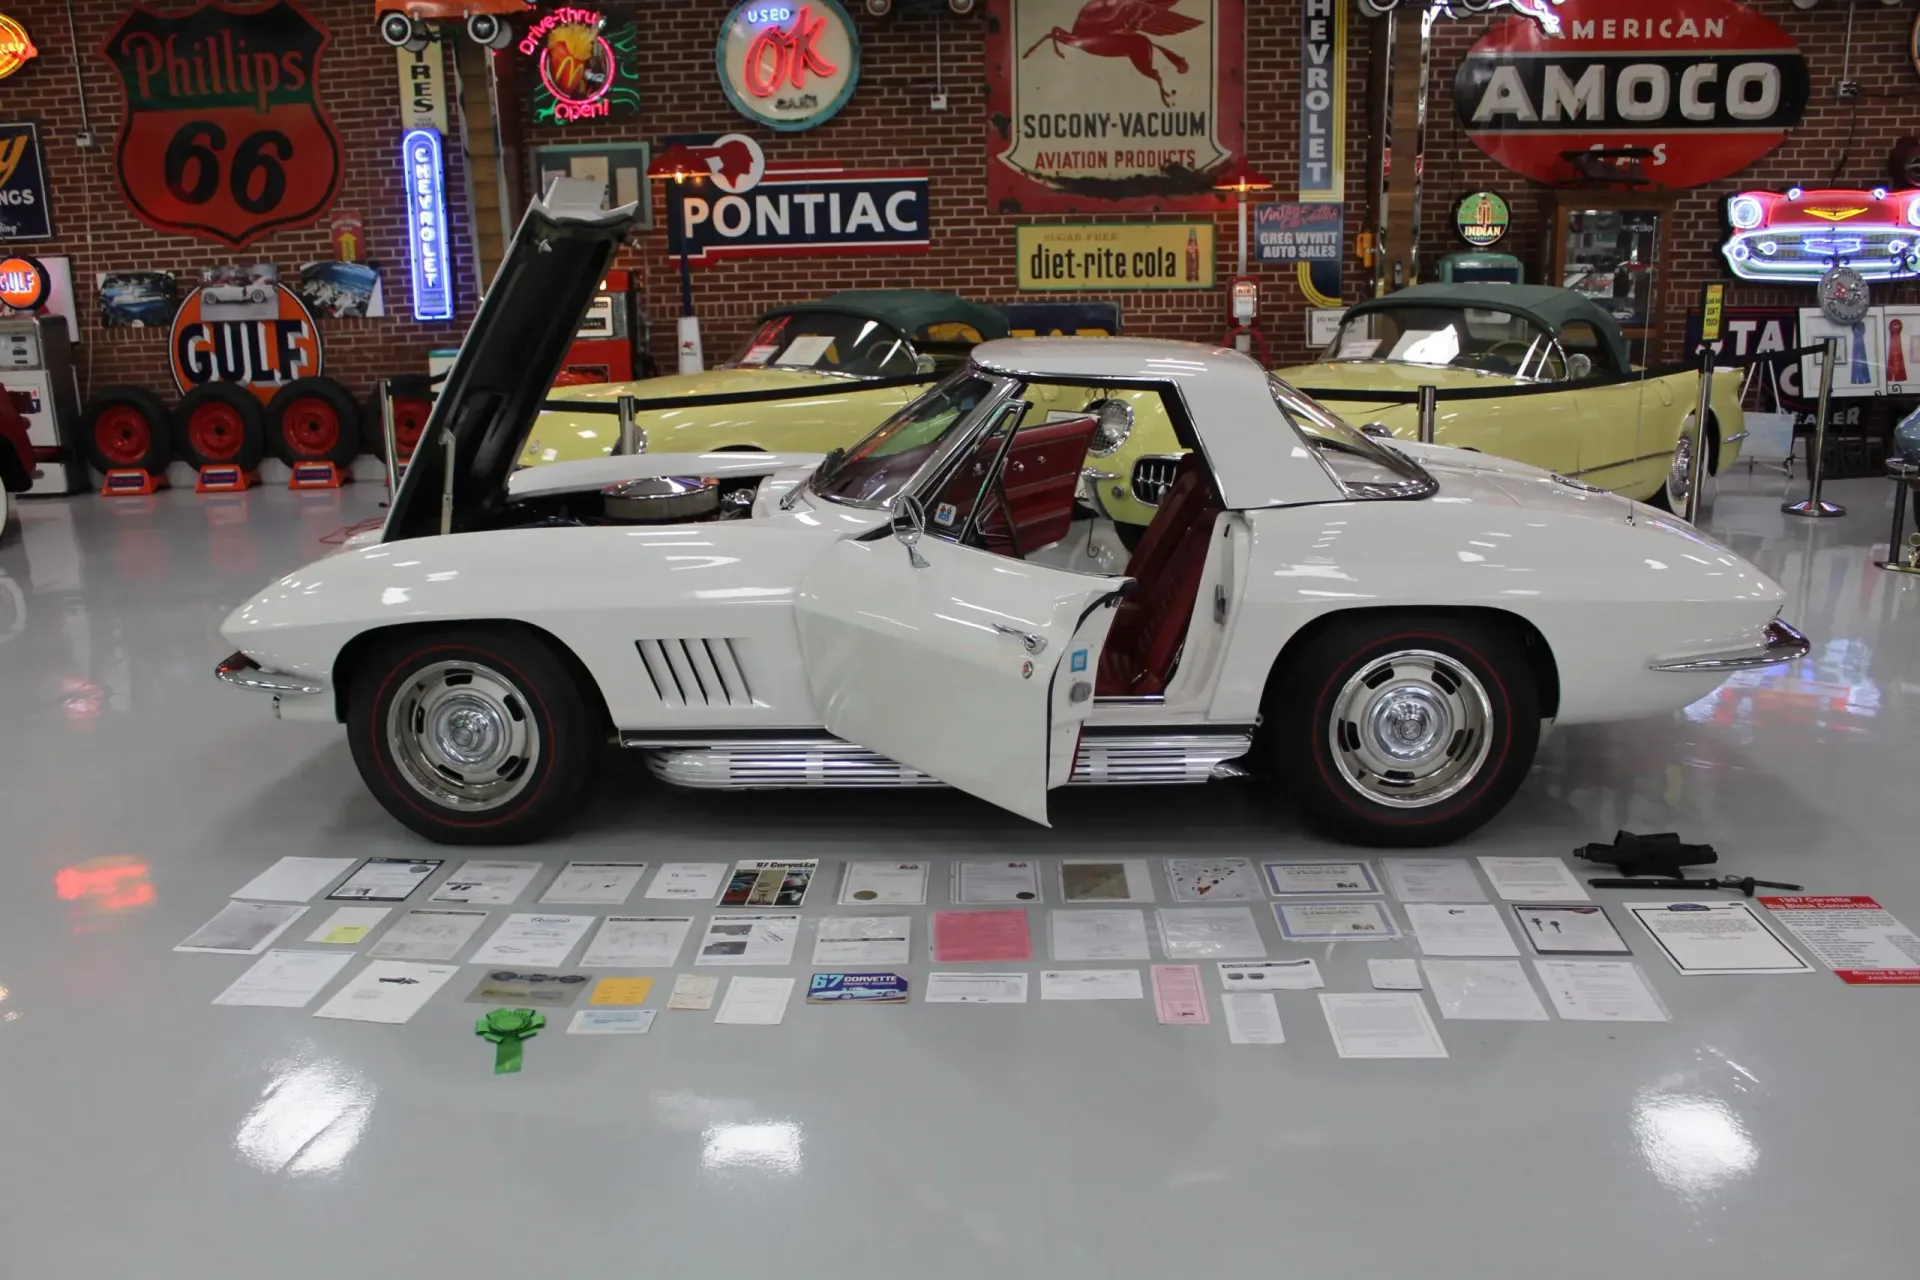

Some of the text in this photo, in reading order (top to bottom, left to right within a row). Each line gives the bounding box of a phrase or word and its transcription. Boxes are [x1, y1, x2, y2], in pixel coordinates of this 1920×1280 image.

[747, 8, 790, 22] USED
[1542, 18, 1724, 40] MERICAN
[744, 5, 837, 97] OK
[121, 28, 306, 113] Phillips
[1471, 62, 1782, 122] AMOCO
[554, 98, 609, 122] Open!
[1023, 111, 1206, 139] SOCONY-VACUUM
[163, 121, 293, 214] 66
[1035, 149, 1196, 173] AVIATION PRODUCTS
[414, 147, 438, 288] CHEVROLET
[683, 190, 918, 239] PONTIAC
[1260, 231, 1338, 245] GREG WYATT
[1464, 226, 1502, 237] INDIAN
[1031, 243, 1176, 279] diet-rite cola
[1263, 245, 1336, 258] AUTO SALES
[0, 271, 35, 294] GULF
[178, 320, 309, 386] GULF
[811, 974, 844, 988] 67
